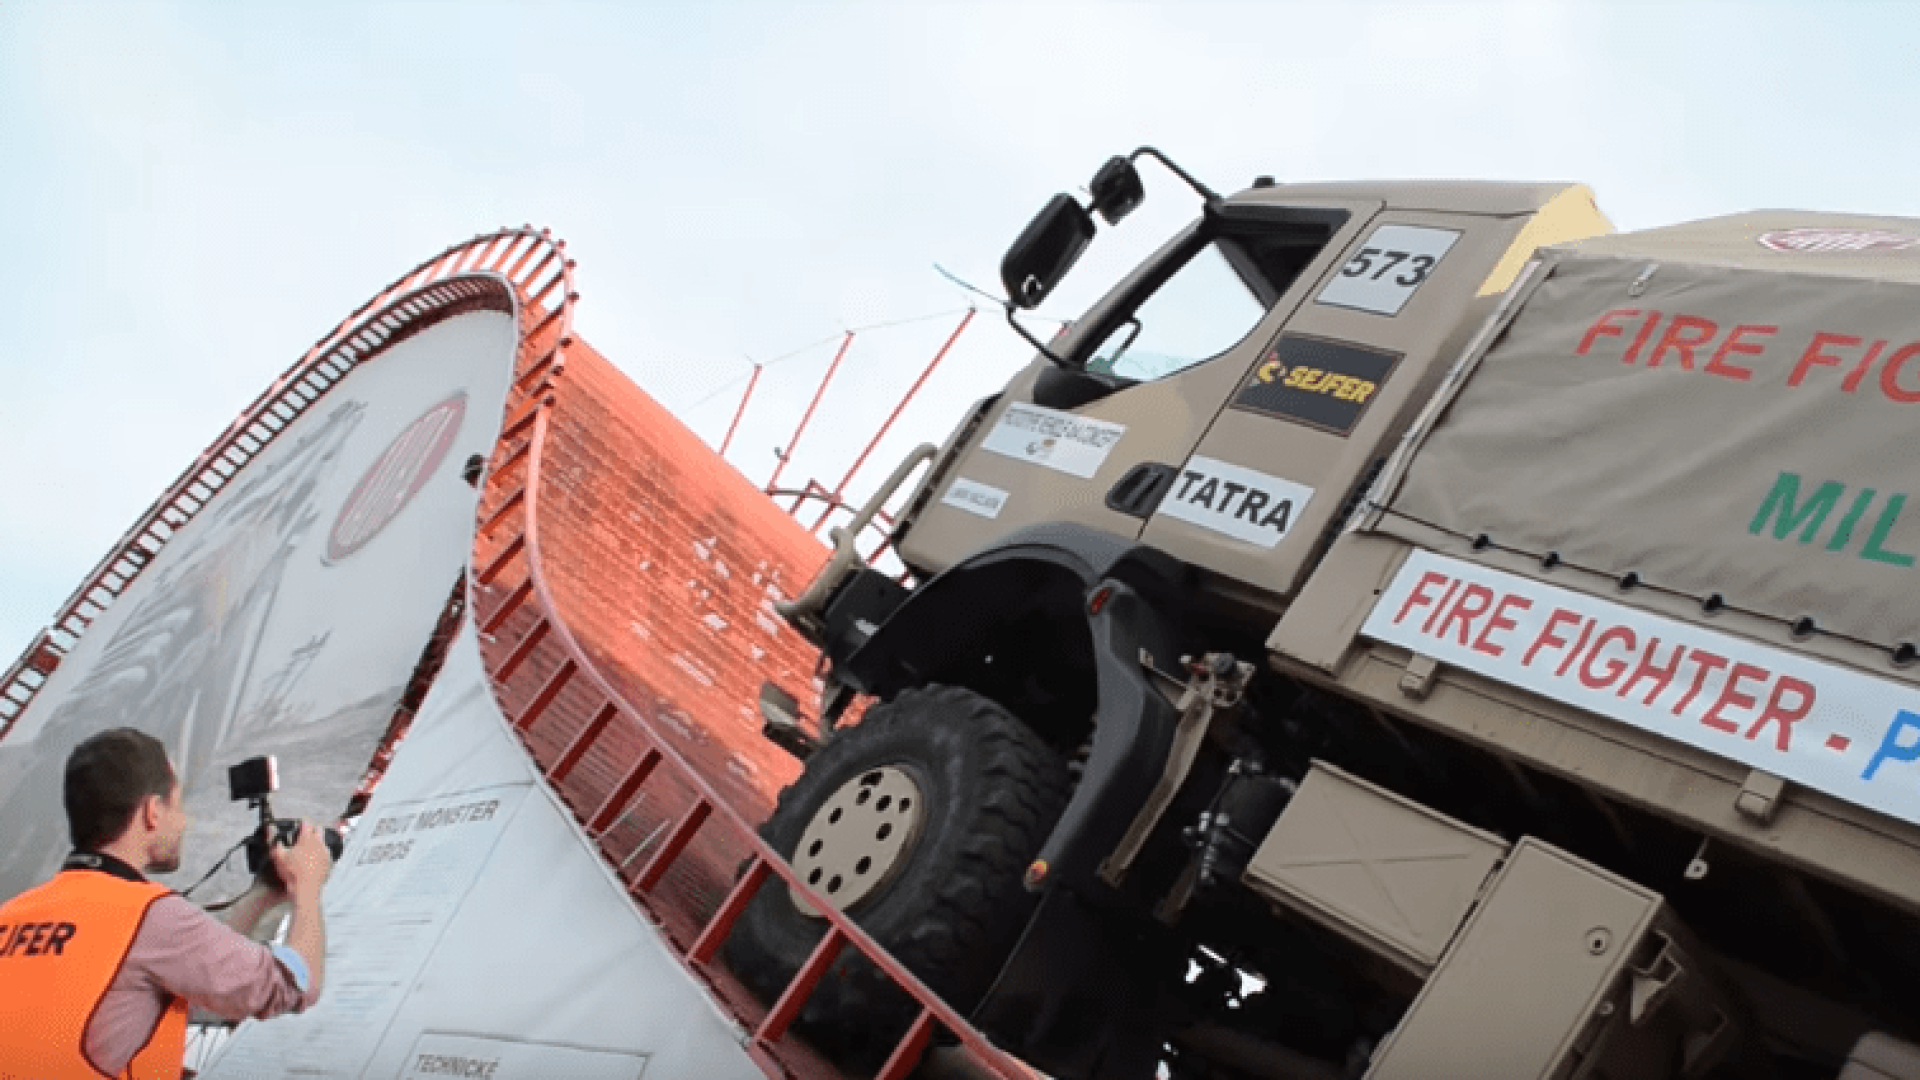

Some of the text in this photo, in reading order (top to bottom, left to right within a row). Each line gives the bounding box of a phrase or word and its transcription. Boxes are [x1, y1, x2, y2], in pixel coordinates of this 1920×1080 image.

[1342, 248, 1435, 287] 573
[1575, 308, 1778, 382] FIRE
[1284, 365, 1377, 403] SEJFER
[1174, 469, 1294, 533] TATRA
[1747, 471, 1917, 568] MIL
[1393, 571, 1532, 656] FIRE
[1520, 609, 1817, 752] FIGHTER
[414, 799, 499, 831] MONSTER
